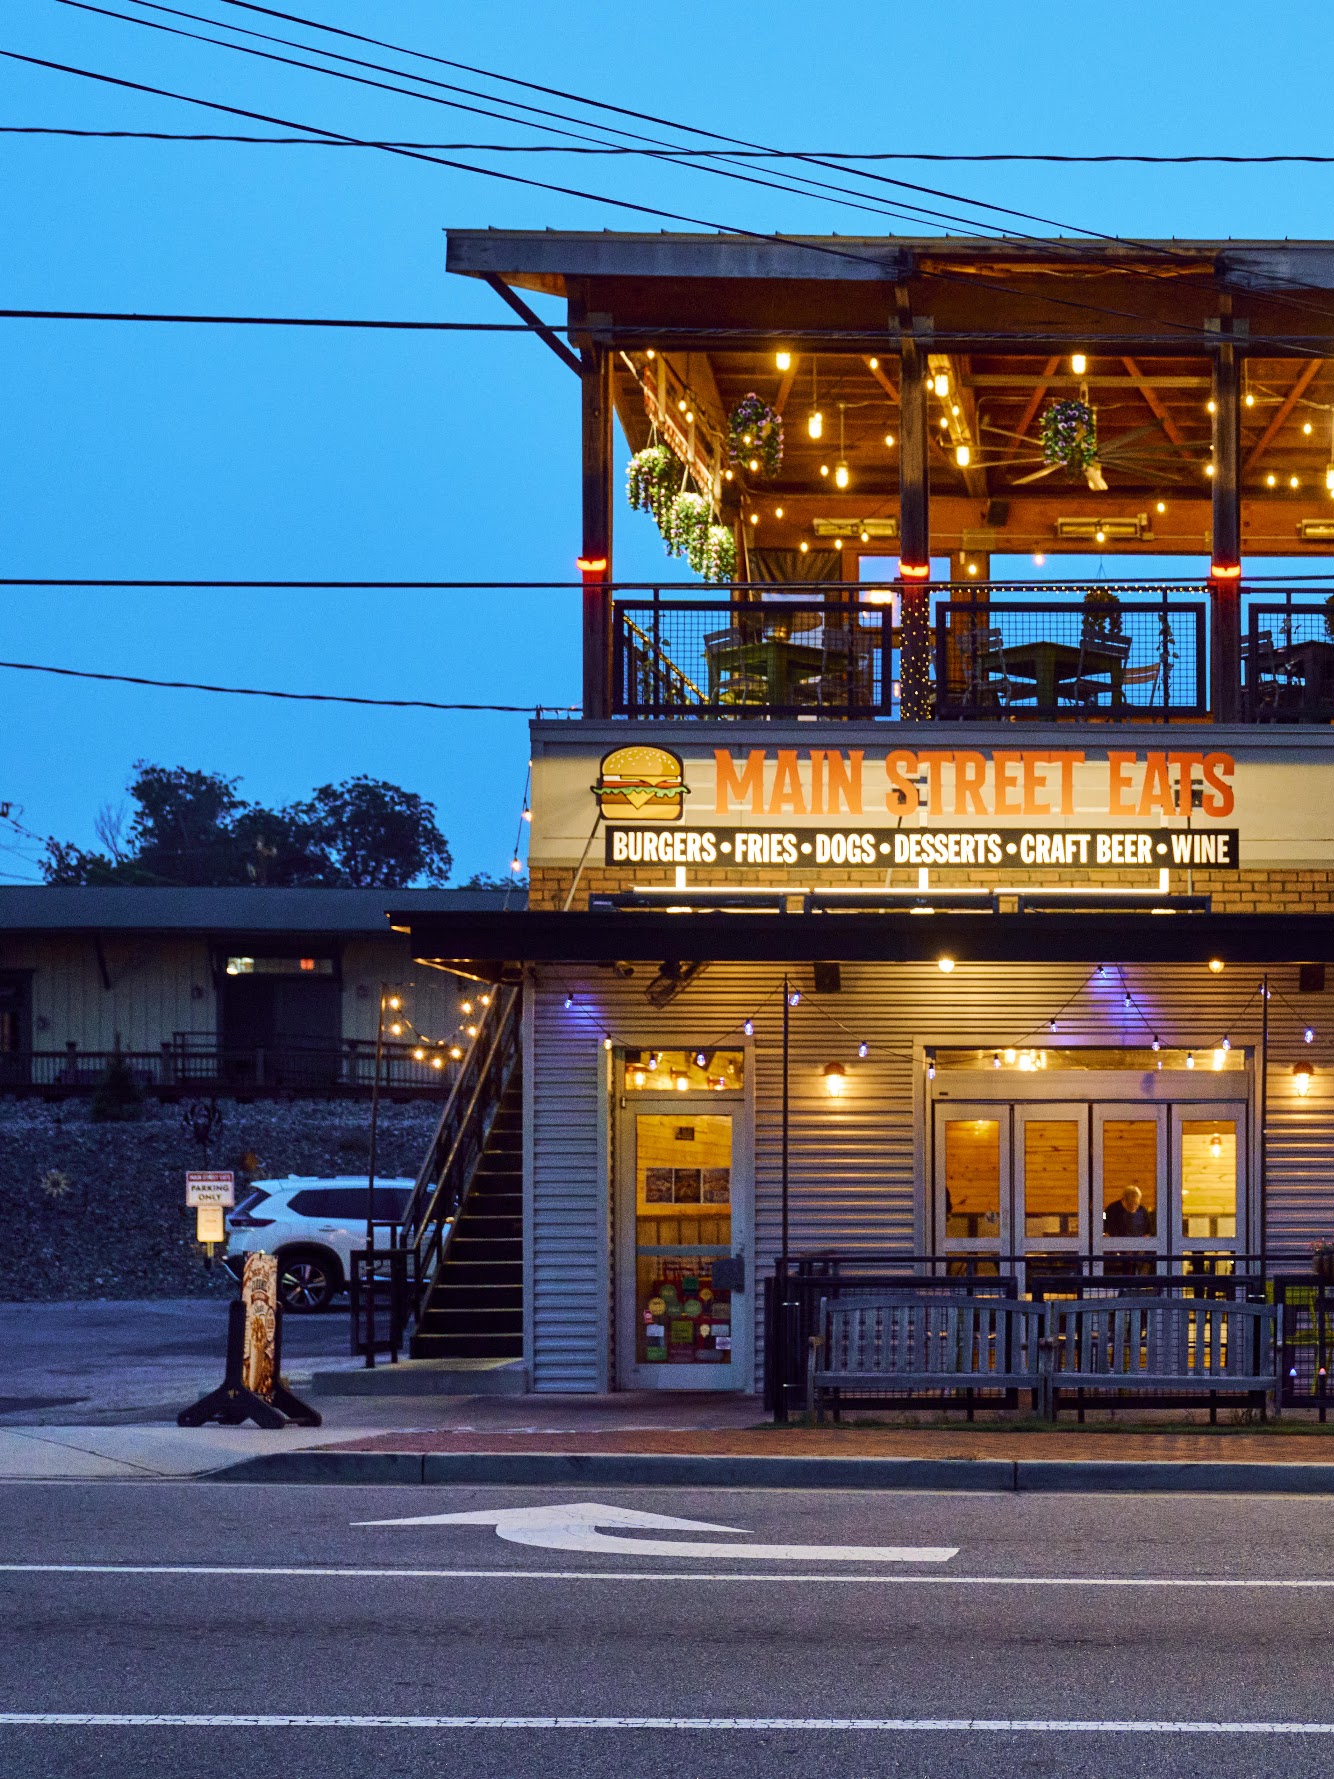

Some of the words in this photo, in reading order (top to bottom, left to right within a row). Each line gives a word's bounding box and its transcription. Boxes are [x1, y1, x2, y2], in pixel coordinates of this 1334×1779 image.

[713, 749, 865, 816] MAIN
[885, 749, 1085, 817] STREET
[1107, 750, 1235, 818] EATS
[613, 831, 717, 863] BURGERS
[735, 832, 798, 864] FRIES
[815, 833, 876, 864] DOGS
[894, 833, 1002, 864] DESSERTS
[1020, 834, 1091, 864] CRAFT
[1096, 834, 1153, 864] BEER
[1171, 834, 1230, 864] WINE
[191, 1184, 229, 1192] PARKING
[198, 1193, 221, 1201] ONLY
